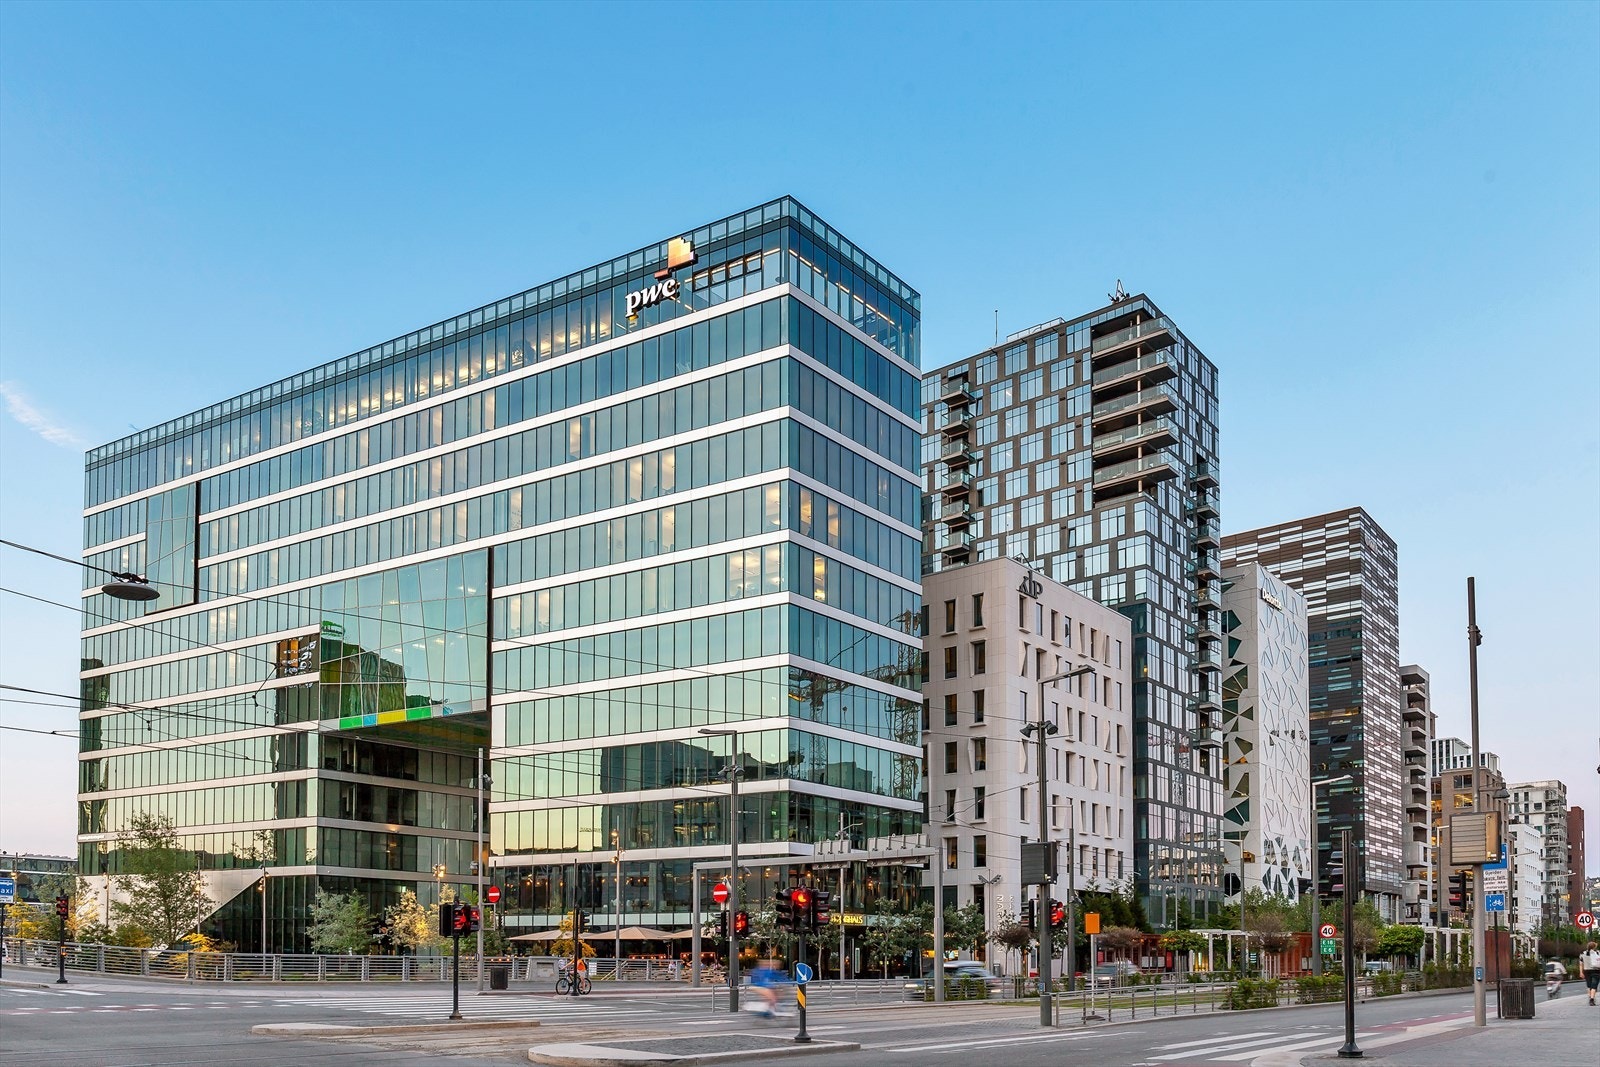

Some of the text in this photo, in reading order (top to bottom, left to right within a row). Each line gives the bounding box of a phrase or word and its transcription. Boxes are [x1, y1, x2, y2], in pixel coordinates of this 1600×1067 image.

[625, 279, 676, 317] pwc
[1579, 915, 1591, 924] 40
[1322, 927, 1334, 935] 40
